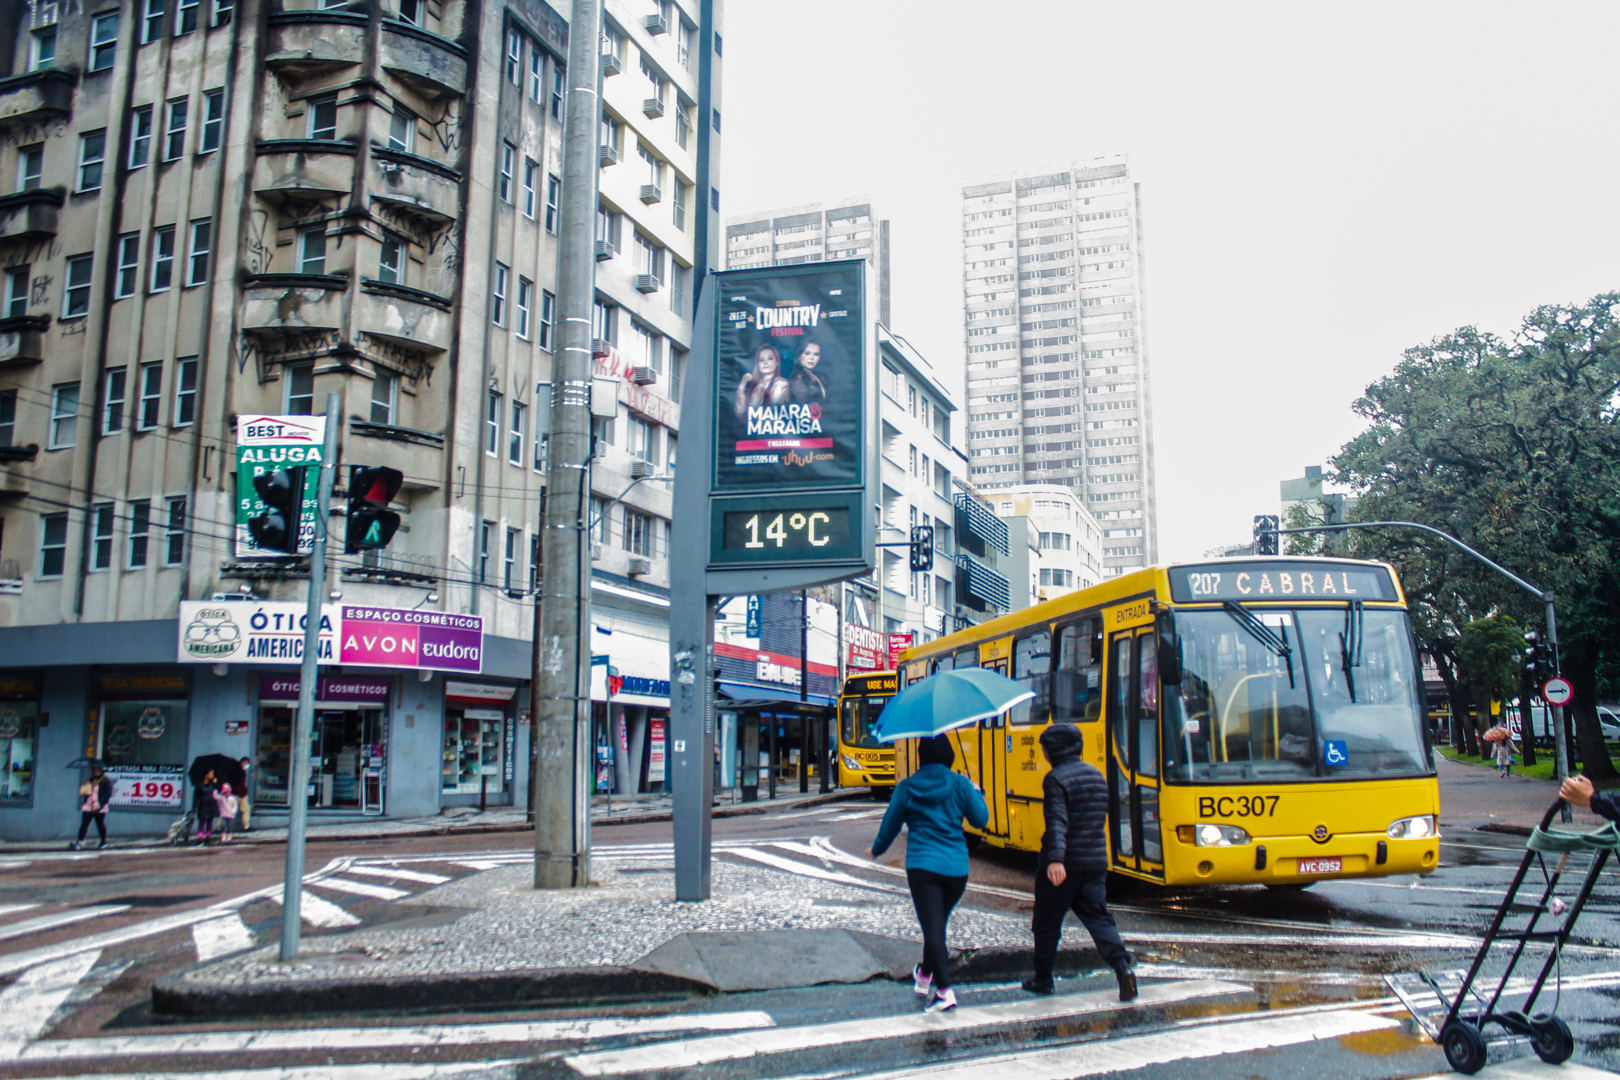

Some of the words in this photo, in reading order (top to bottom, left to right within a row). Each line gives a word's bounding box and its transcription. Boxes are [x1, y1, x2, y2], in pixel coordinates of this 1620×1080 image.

[756, 304, 820, 330] COUNTRY
[771, 327, 804, 336] FESTIVAL
[748, 404, 811, 421] MAIARA
[810, 402, 823, 420] &
[247, 425, 285, 437] BEST
[747, 419, 822, 435] MARAISA
[240, 447, 322, 463] ALUGA
[735, 455, 767, 465] INGRESSOS
[768, 454, 779, 464] EM
[1191, 573, 1221, 594] 207
[1236, 572, 1357, 594] CABRAL
[200, 609, 226, 618] ÓTICA
[346, 609, 401, 622] ESPAÇO
[404, 614, 480, 629] COSMÉTICOS
[1116, 609, 1147, 624] ENTRADA
[344, 634, 416, 653] AVON
[849, 624, 884, 653] DENTISTA
[188, 643, 235, 655] AMERICANA
[247, 638, 333, 659] AMERICNA
[272, 681, 300, 691] ÓTIC
[329, 684, 388, 695] COSMÉTICOS
[867, 680, 882, 690] USE
[1021, 734, 1035, 746] cidade
[1199, 796, 1280, 818] BC307
